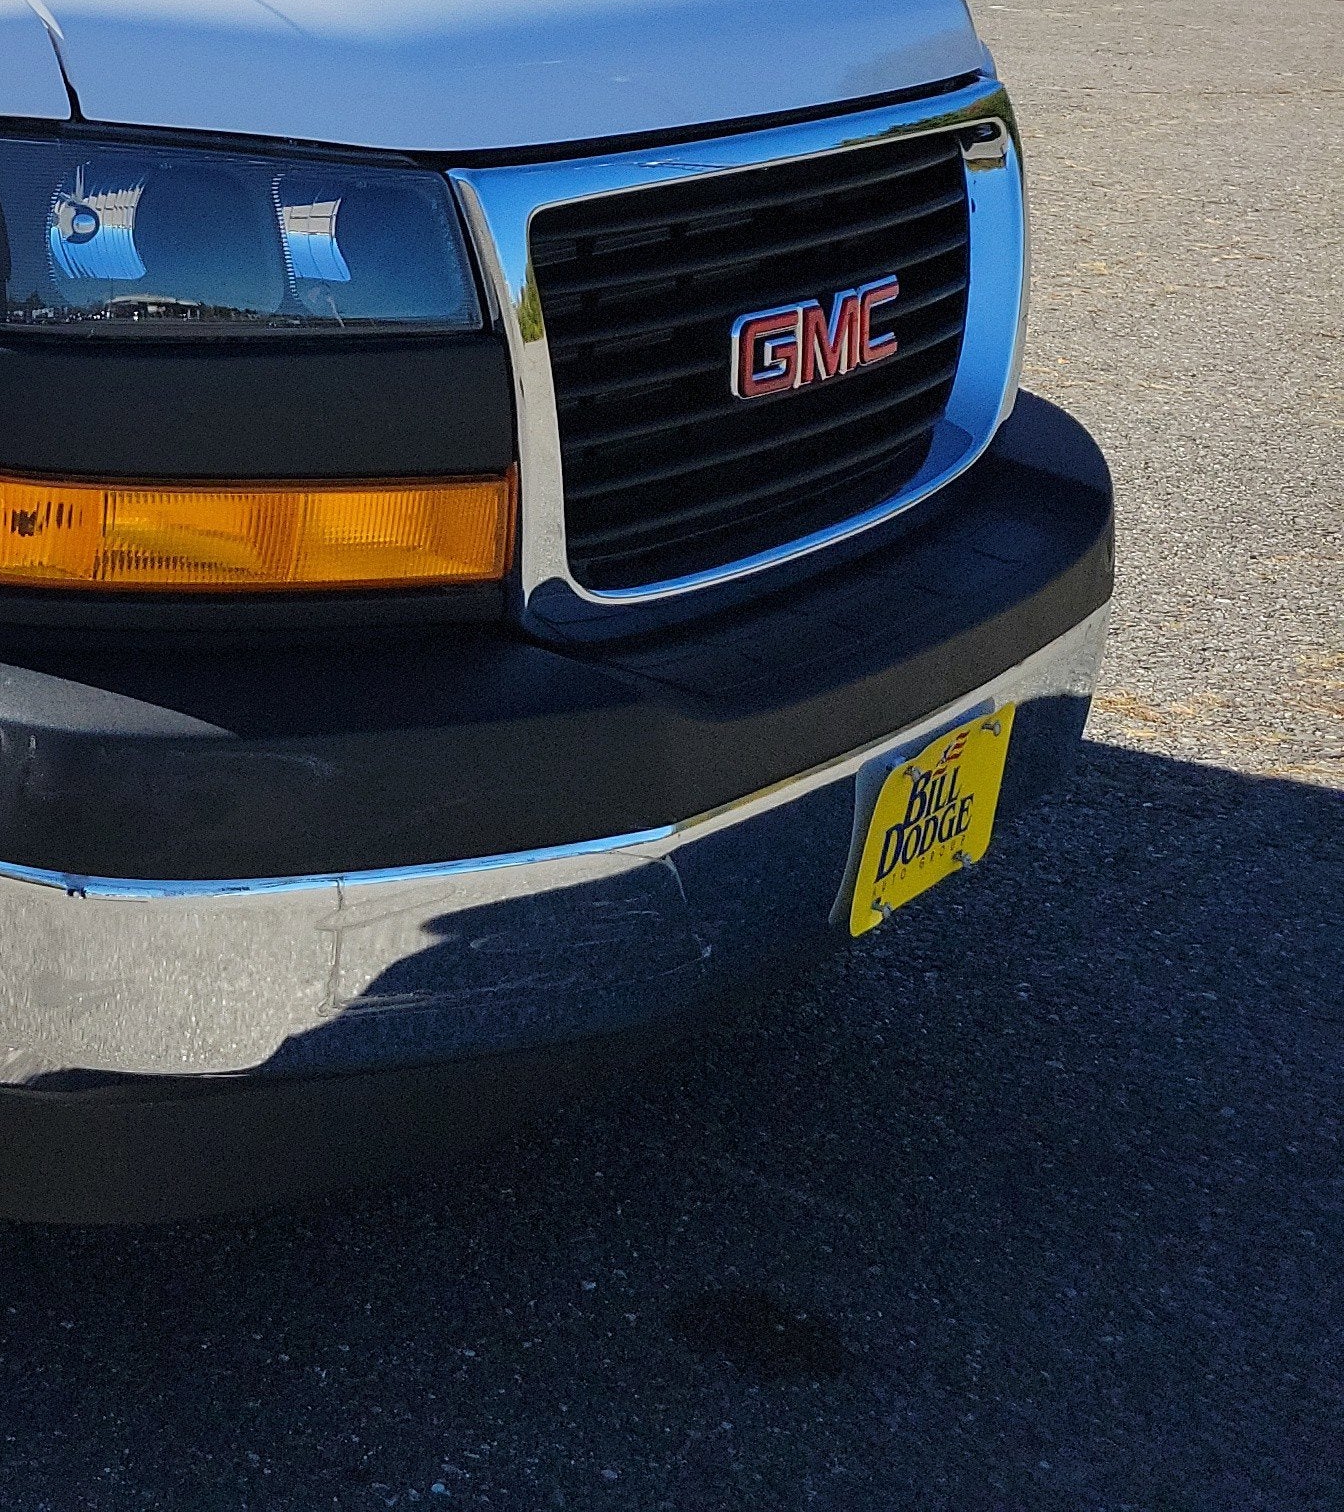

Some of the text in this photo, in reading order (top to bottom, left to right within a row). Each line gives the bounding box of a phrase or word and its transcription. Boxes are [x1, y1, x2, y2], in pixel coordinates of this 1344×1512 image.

[730, 274, 900, 400] GMC
[873, 792, 975, 884] DODGE
[902, 764, 961, 832] BILL
